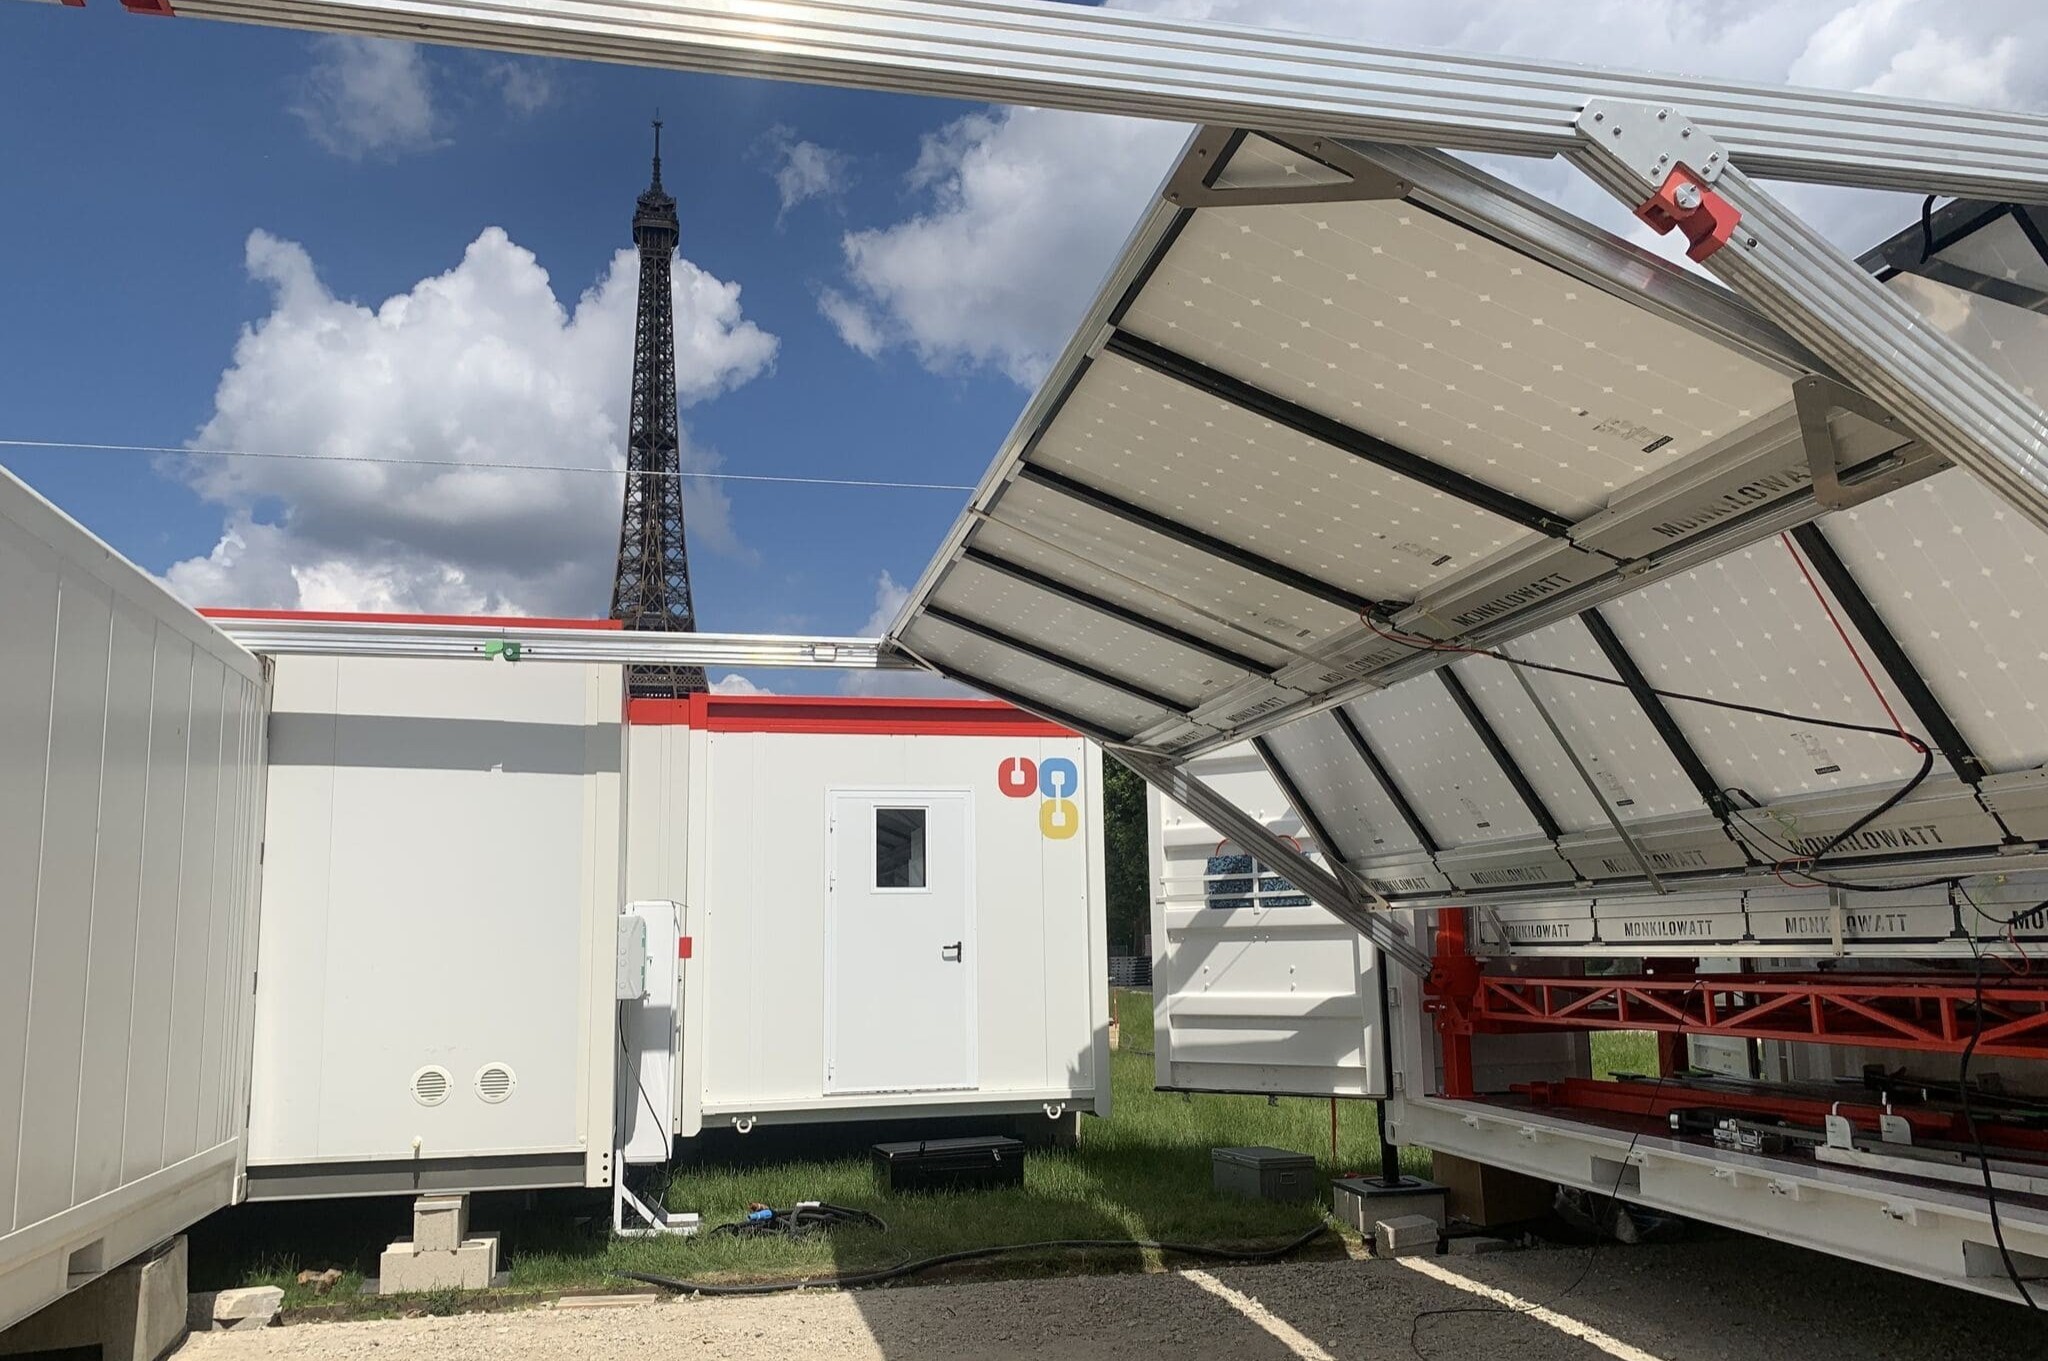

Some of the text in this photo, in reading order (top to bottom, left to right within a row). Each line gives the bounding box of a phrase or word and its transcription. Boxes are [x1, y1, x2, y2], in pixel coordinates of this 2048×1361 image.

[1451, 572, 1572, 627] MONKILOWATT
[1470, 866, 1548, 884] MONKILOWATT
[1371, 877, 1431, 892] MONKILOWATT
[1625, 920, 1713, 937] MONKILOWATT
